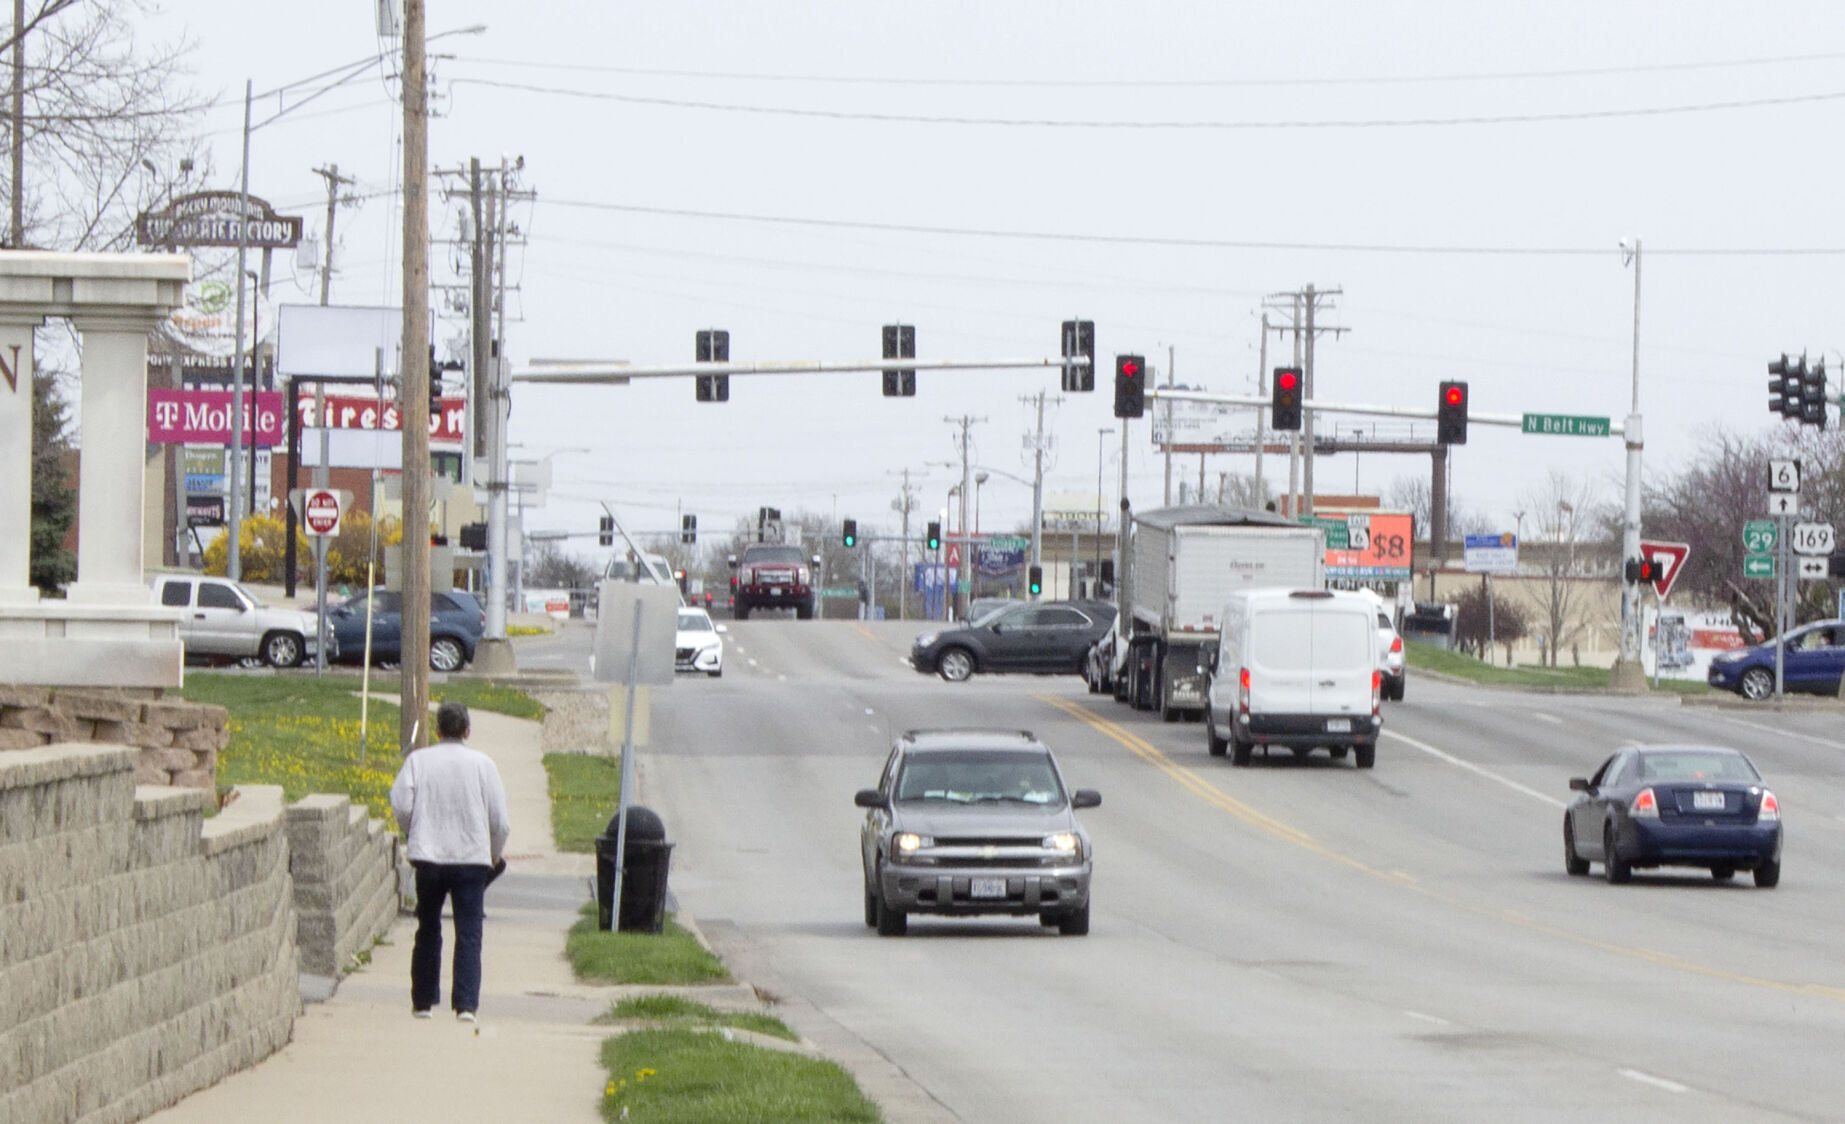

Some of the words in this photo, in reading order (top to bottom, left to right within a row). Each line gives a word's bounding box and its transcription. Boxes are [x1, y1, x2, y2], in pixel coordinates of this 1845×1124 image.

[229, 220, 293, 244] FCTORY
[155, 401, 179, 430] T
[1528, 416, 1537, 432] N
[1543, 416, 1574, 433] Belt
[1579, 420, 1604, 434] Hwy
[1778, 463, 1790, 484] 6
[1355, 530, 1363, 544] 6
[1373, 533, 1404, 559] $8
[1749, 532, 1773, 549] 29
[1799, 531, 1829, 547] 169
